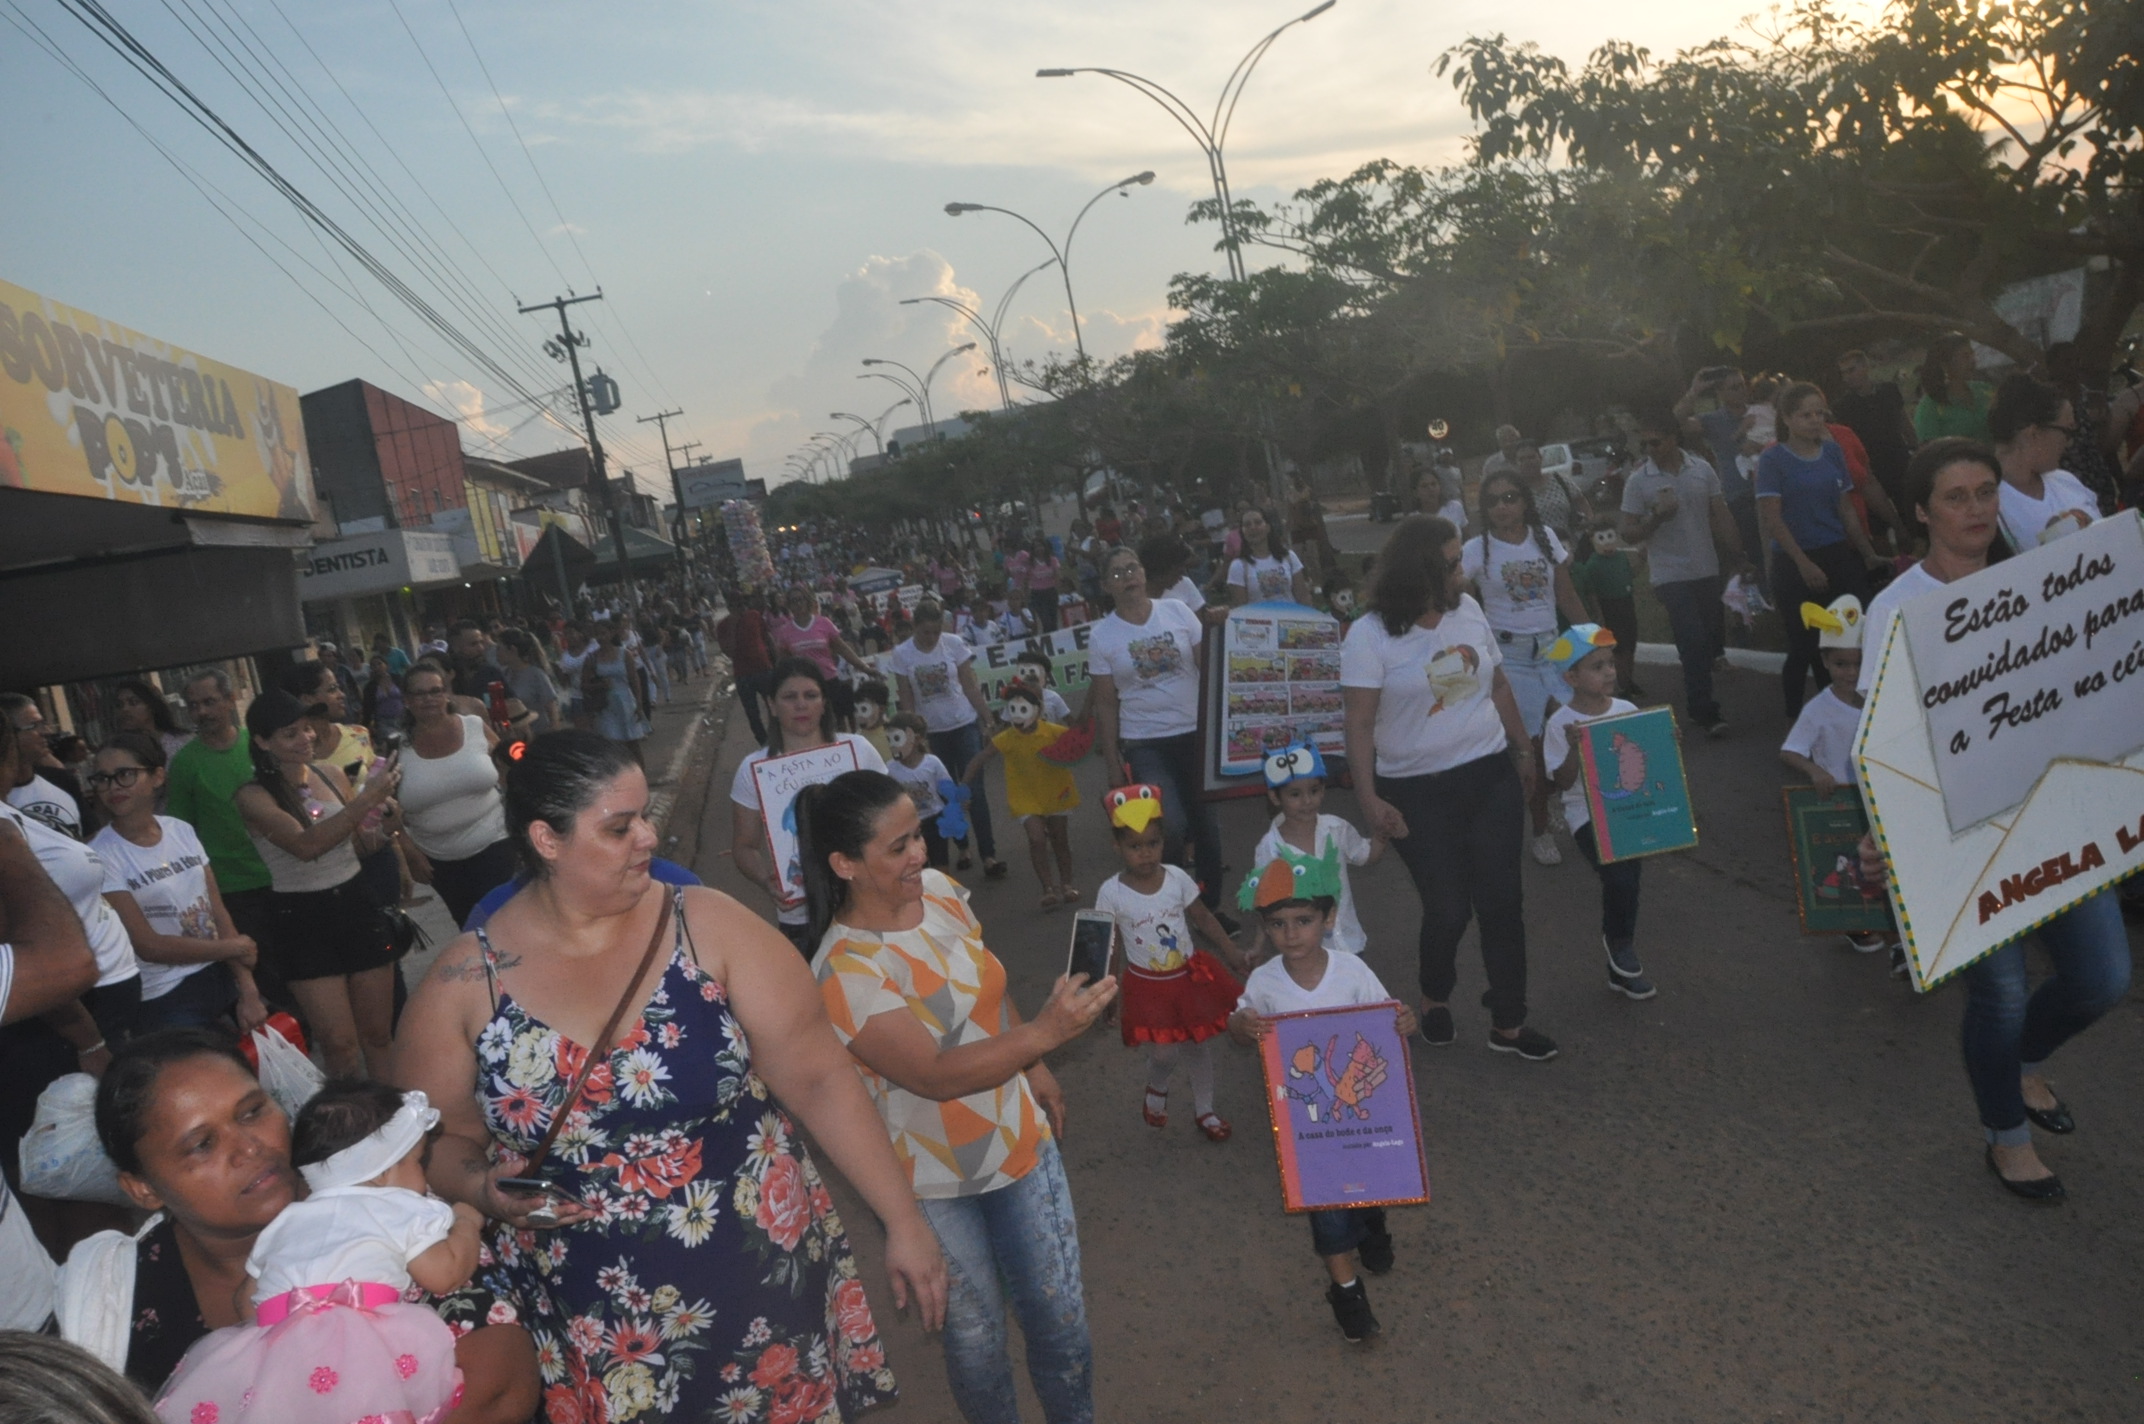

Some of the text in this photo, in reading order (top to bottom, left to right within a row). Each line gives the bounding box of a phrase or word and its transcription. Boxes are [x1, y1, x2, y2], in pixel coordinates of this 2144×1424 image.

[0, 303, 245, 440] SORVETERIA
[303, 547, 389, 577] DENTISTA
[1945, 553, 2115, 643] Estão todos
[1923, 589, 2144, 708] convidados para
[1950, 730, 1970, 754] a
[1982, 692, 2063, 740] Festa
[2074, 671, 2108, 698] no
[768, 770, 777, 781] A
[781, 759, 814, 775] FESTA
[1978, 842, 2105, 925] ANGELA
[1298, 1132, 1305, 1140] A
[1325, 1129, 1335, 1137] do
[1336, 1127, 1355, 1136] bode
[1362, 1126, 1372, 1134] da
